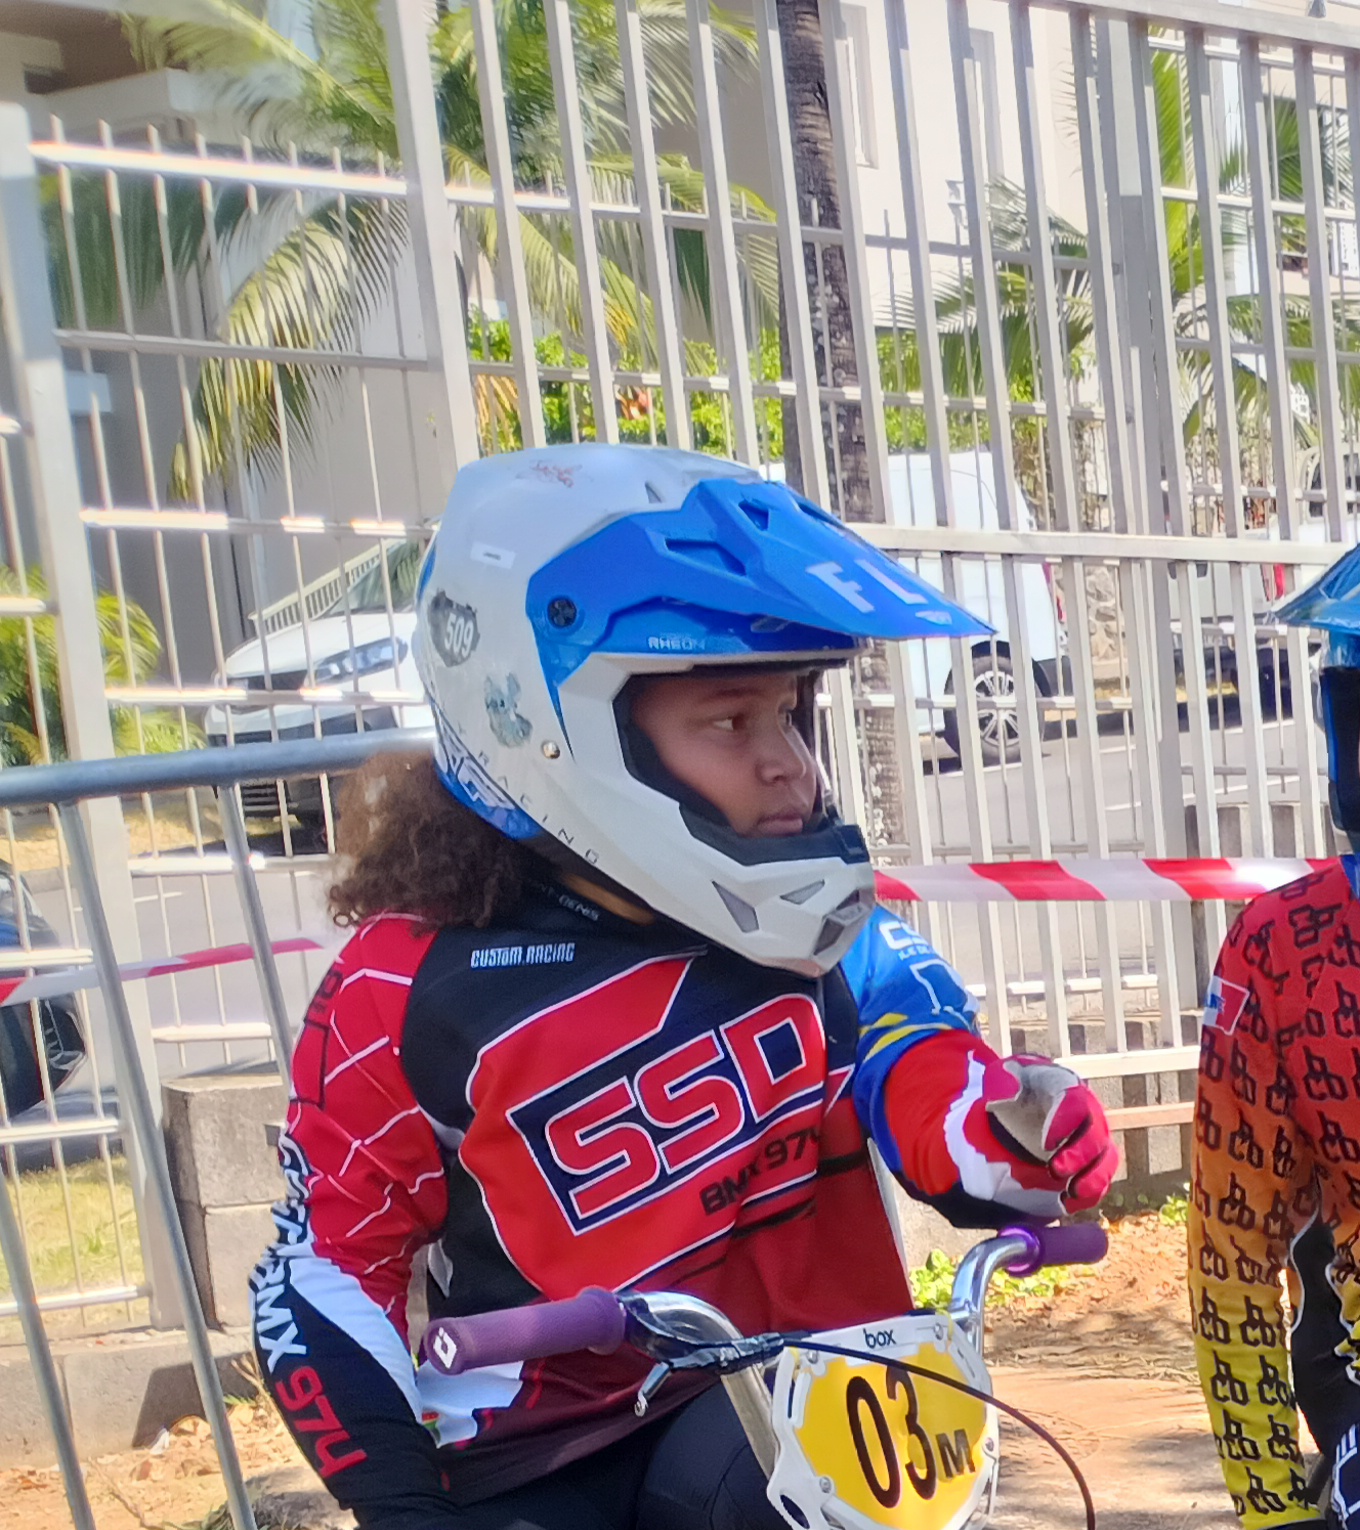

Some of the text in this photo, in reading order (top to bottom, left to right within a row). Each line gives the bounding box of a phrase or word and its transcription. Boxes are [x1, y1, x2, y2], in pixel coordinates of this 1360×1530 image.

[444, 613, 475, 657] 509
[545, 993, 827, 1221] SSD
[863, 1327, 897, 1350] box
[275, 1365, 369, 1480] 974
[845, 1364, 976, 1509] 03 M
